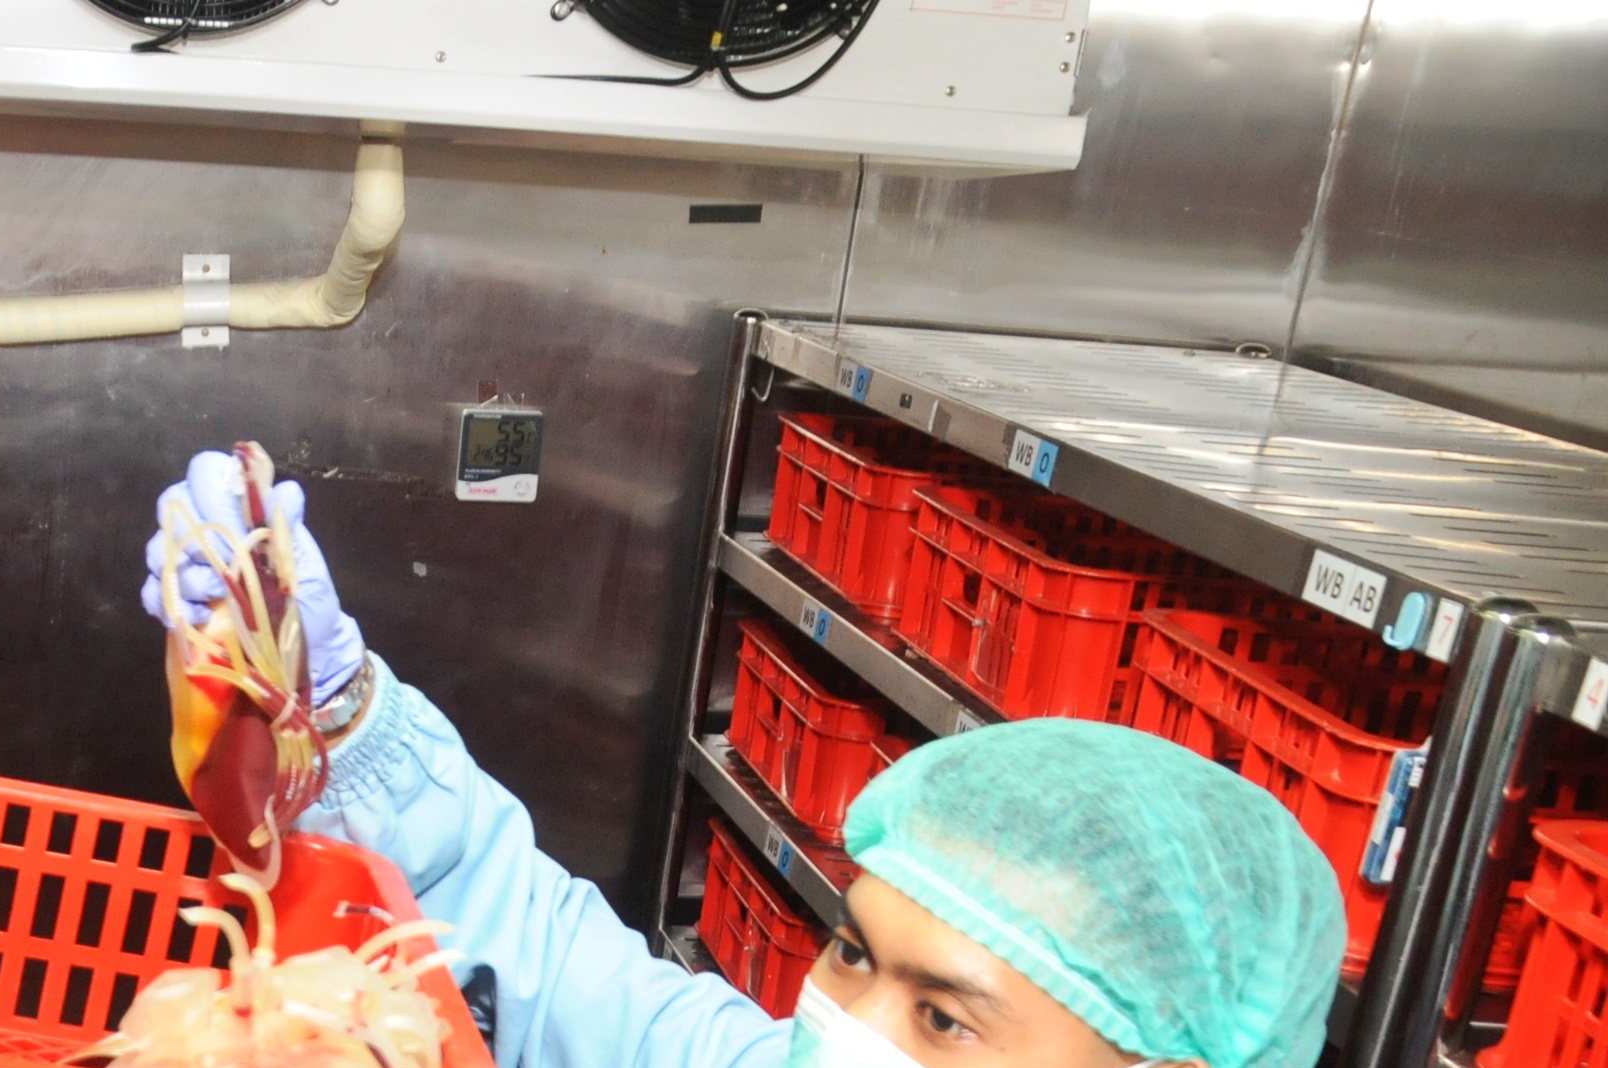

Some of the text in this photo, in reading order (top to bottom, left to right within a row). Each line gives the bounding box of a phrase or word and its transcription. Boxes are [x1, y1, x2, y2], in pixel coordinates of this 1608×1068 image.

[840, 367, 854, 383] WB
[1015, 440, 1035, 467] WB
[1314, 564, 1378, 613] WB AB
[802, 605, 816, 628] WB
[1437, 615, 1454, 645] 7
[1586, 678, 1607, 710] 4
[767, 833, 780, 858] WB
